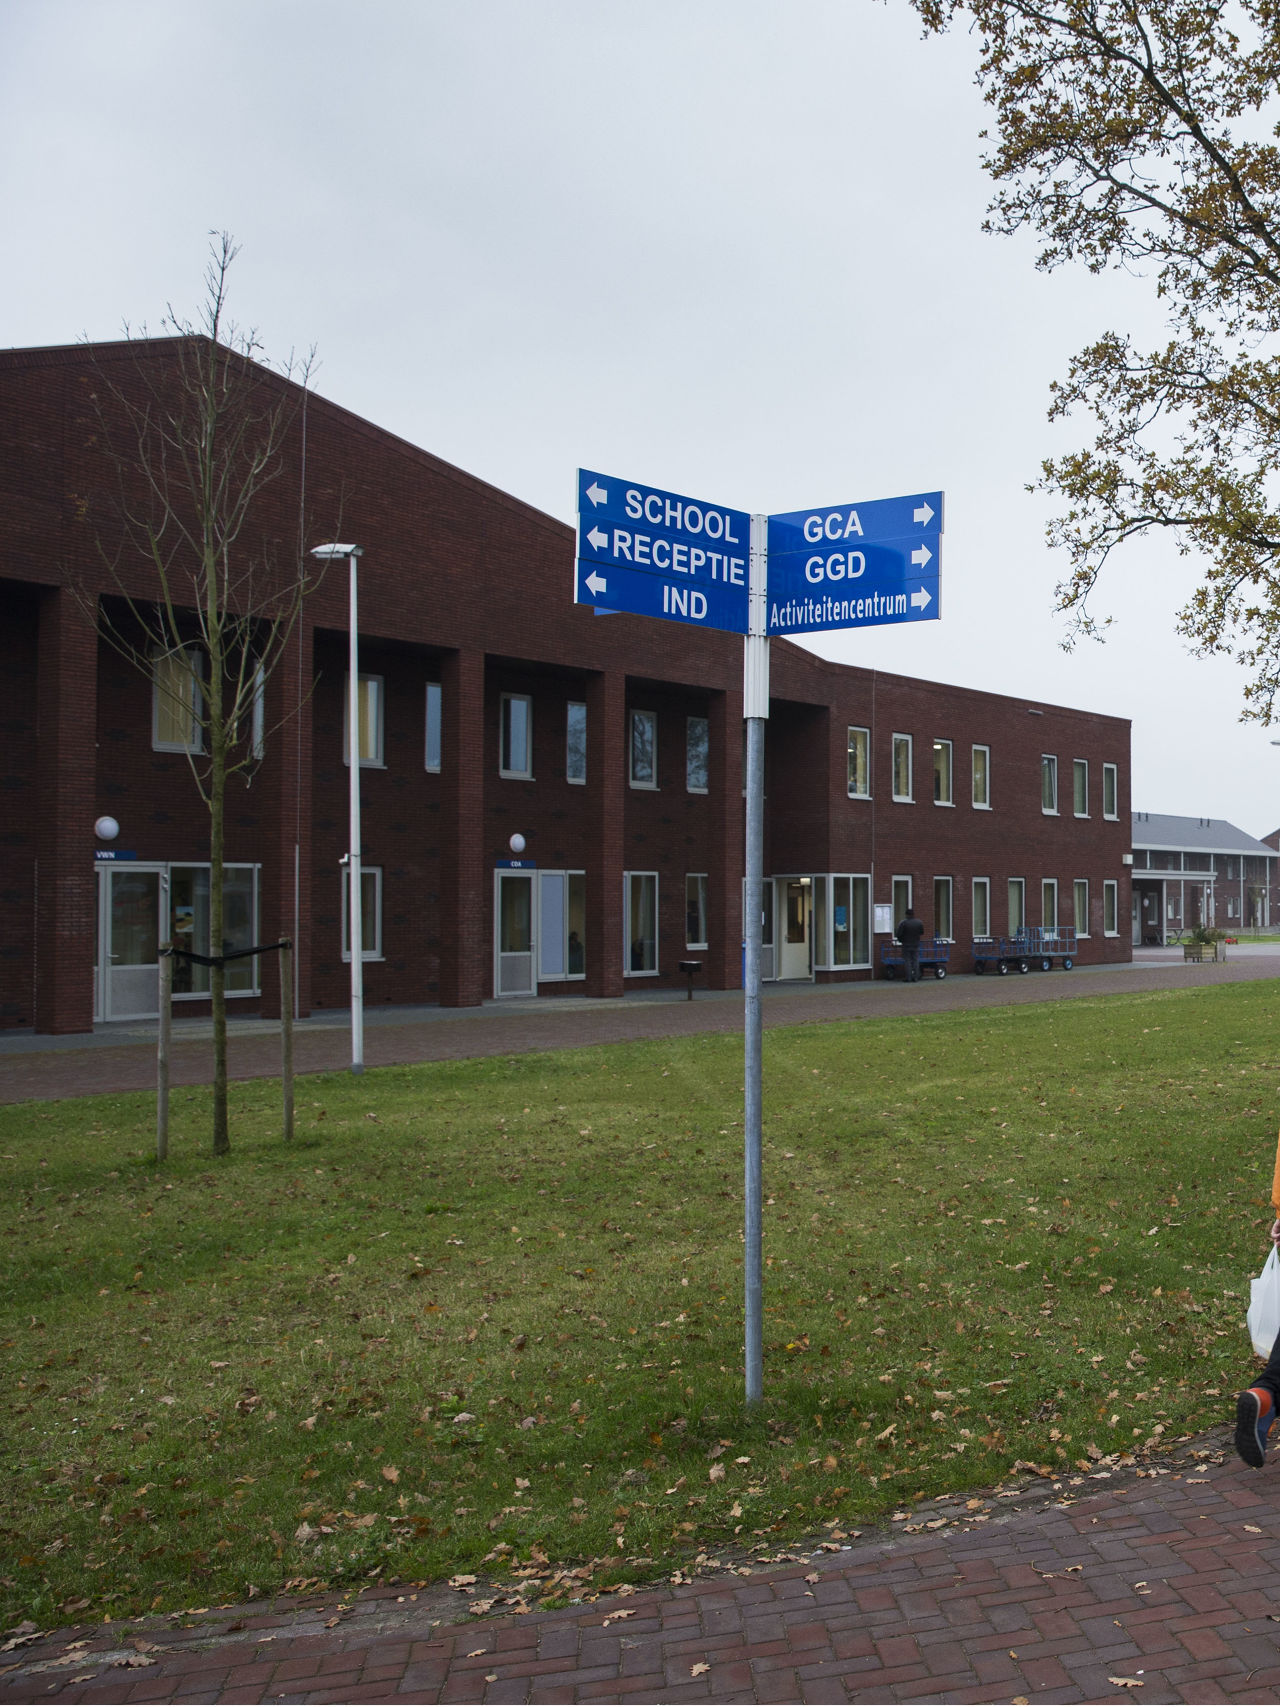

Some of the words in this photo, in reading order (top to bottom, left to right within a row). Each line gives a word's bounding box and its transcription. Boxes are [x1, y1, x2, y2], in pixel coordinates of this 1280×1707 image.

[625, 489, 739, 544] SCHOOL
[803, 510, 864, 543] GCA
[613, 528, 745, 586] RECEPTIE
[805, 551, 866, 583] GGD
[663, 585, 708, 620] IND
[770, 591, 907, 628] Activiteitencentrum
